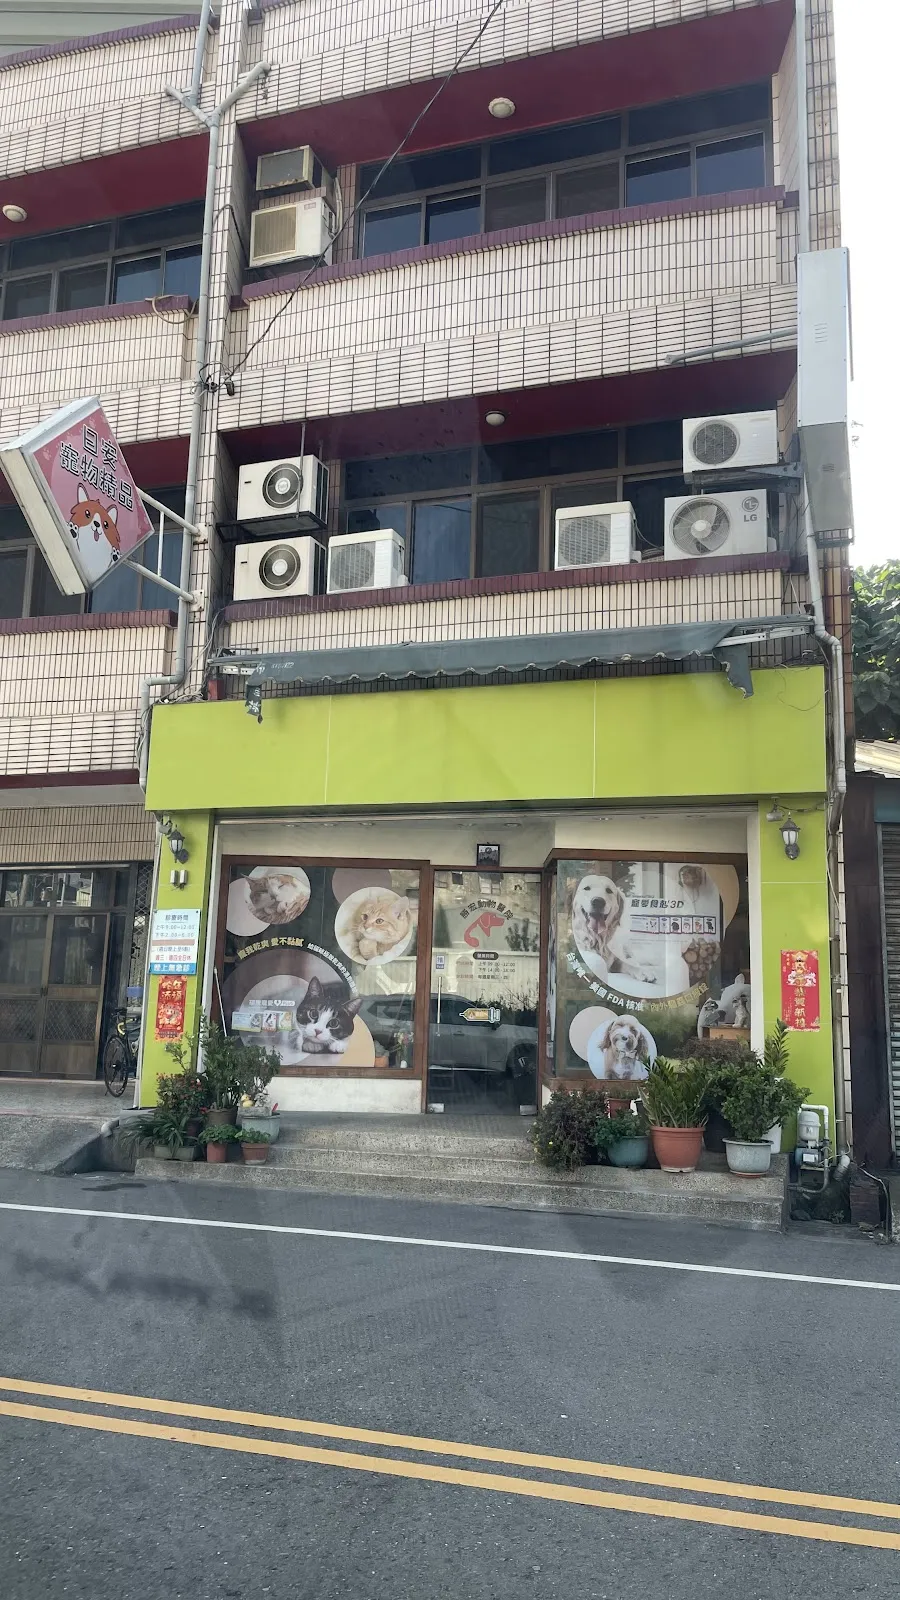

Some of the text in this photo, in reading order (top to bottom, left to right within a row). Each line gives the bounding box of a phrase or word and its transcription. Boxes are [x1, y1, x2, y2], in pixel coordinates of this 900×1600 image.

[83, 423, 117, 471] 日安
[60, 440, 133, 512] 寵物精品
[743, 514, 758, 522] LG
[589, 981, 607, 998] 美國
[607, 993, 624, 1007] FDA
[626, 999, 644, 1011] 核准
